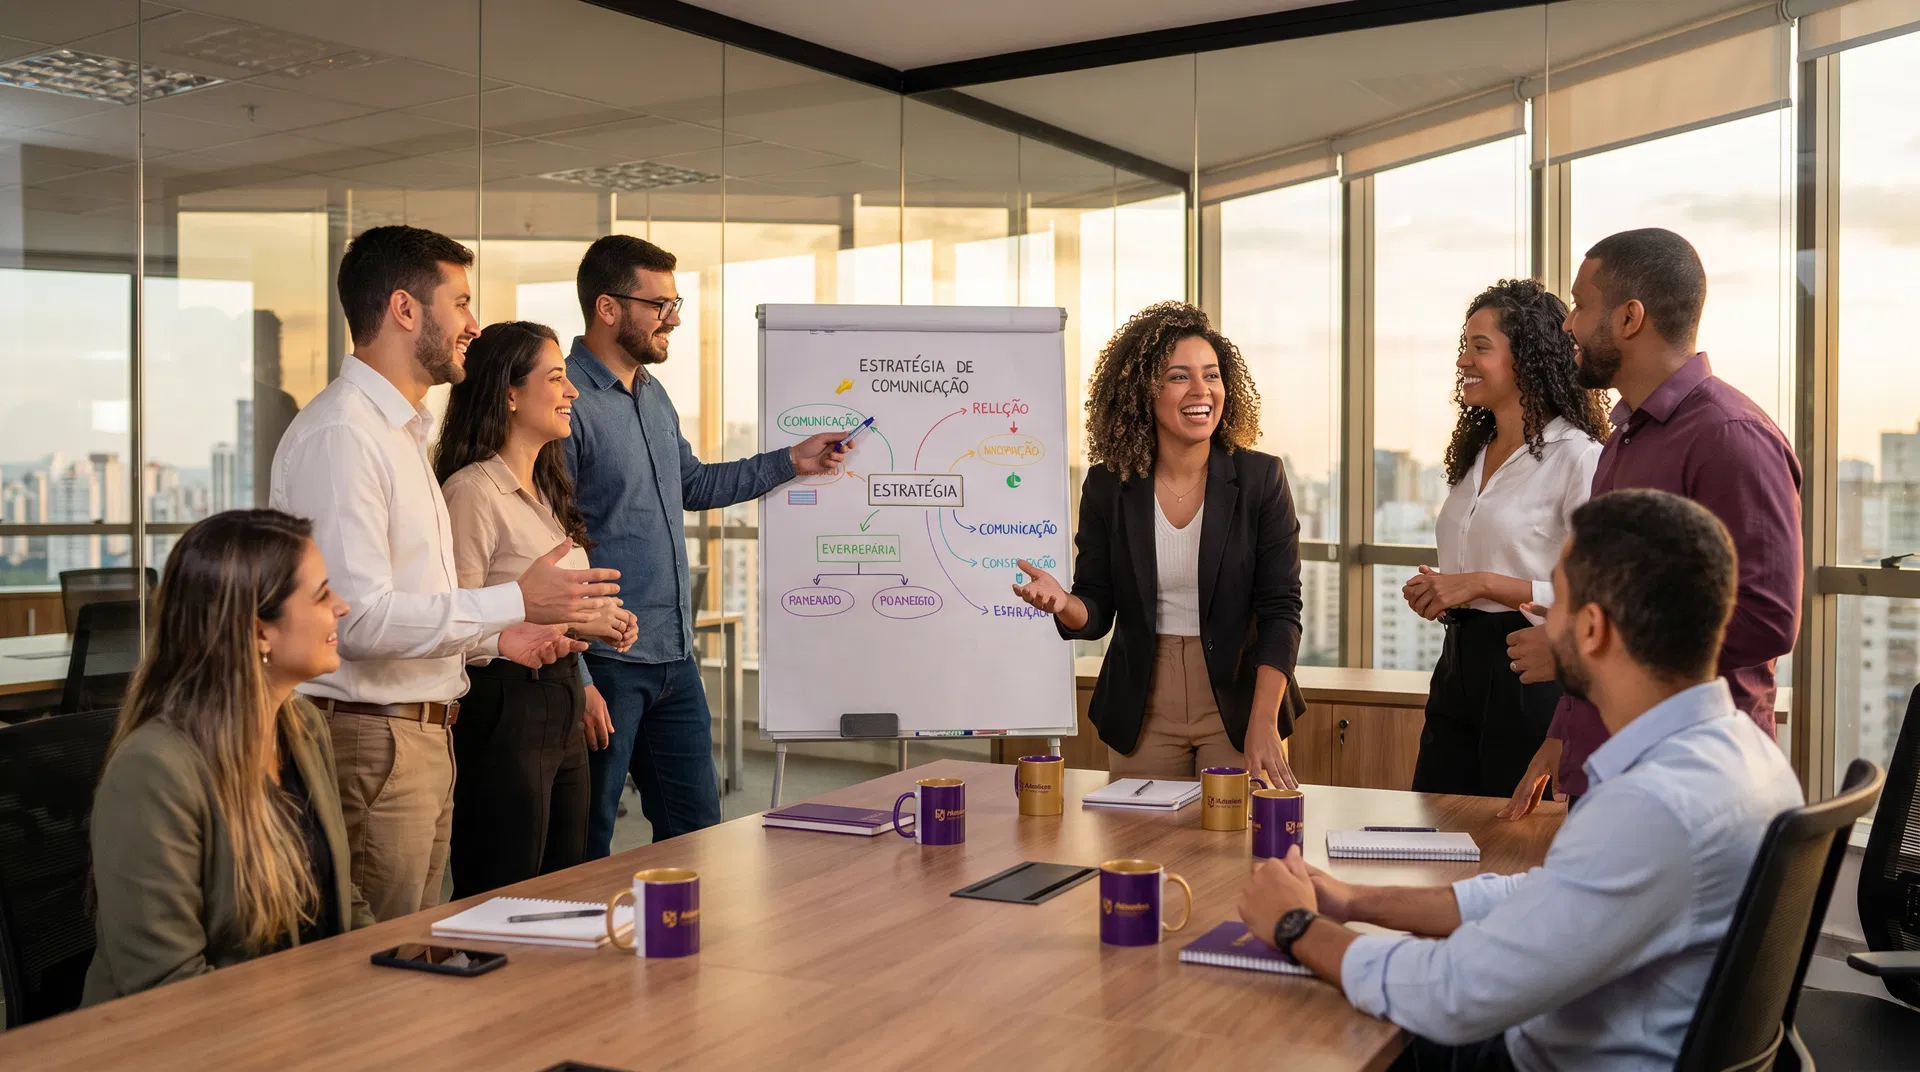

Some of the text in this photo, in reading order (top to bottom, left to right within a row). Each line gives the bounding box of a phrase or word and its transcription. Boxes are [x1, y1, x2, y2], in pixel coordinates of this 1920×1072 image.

[859, 354, 974, 374] ESTRATÉGIA DE
[871, 376, 969, 398] COMUNICAÇÃO
[972, 398, 1029, 418] RELLÇÃO
[783, 412, 860, 430] COMUNICAÇÃO
[873, 478, 958, 498] ESTRATÉGIA
[979, 519, 1058, 538] COMUNICAÇÃO
